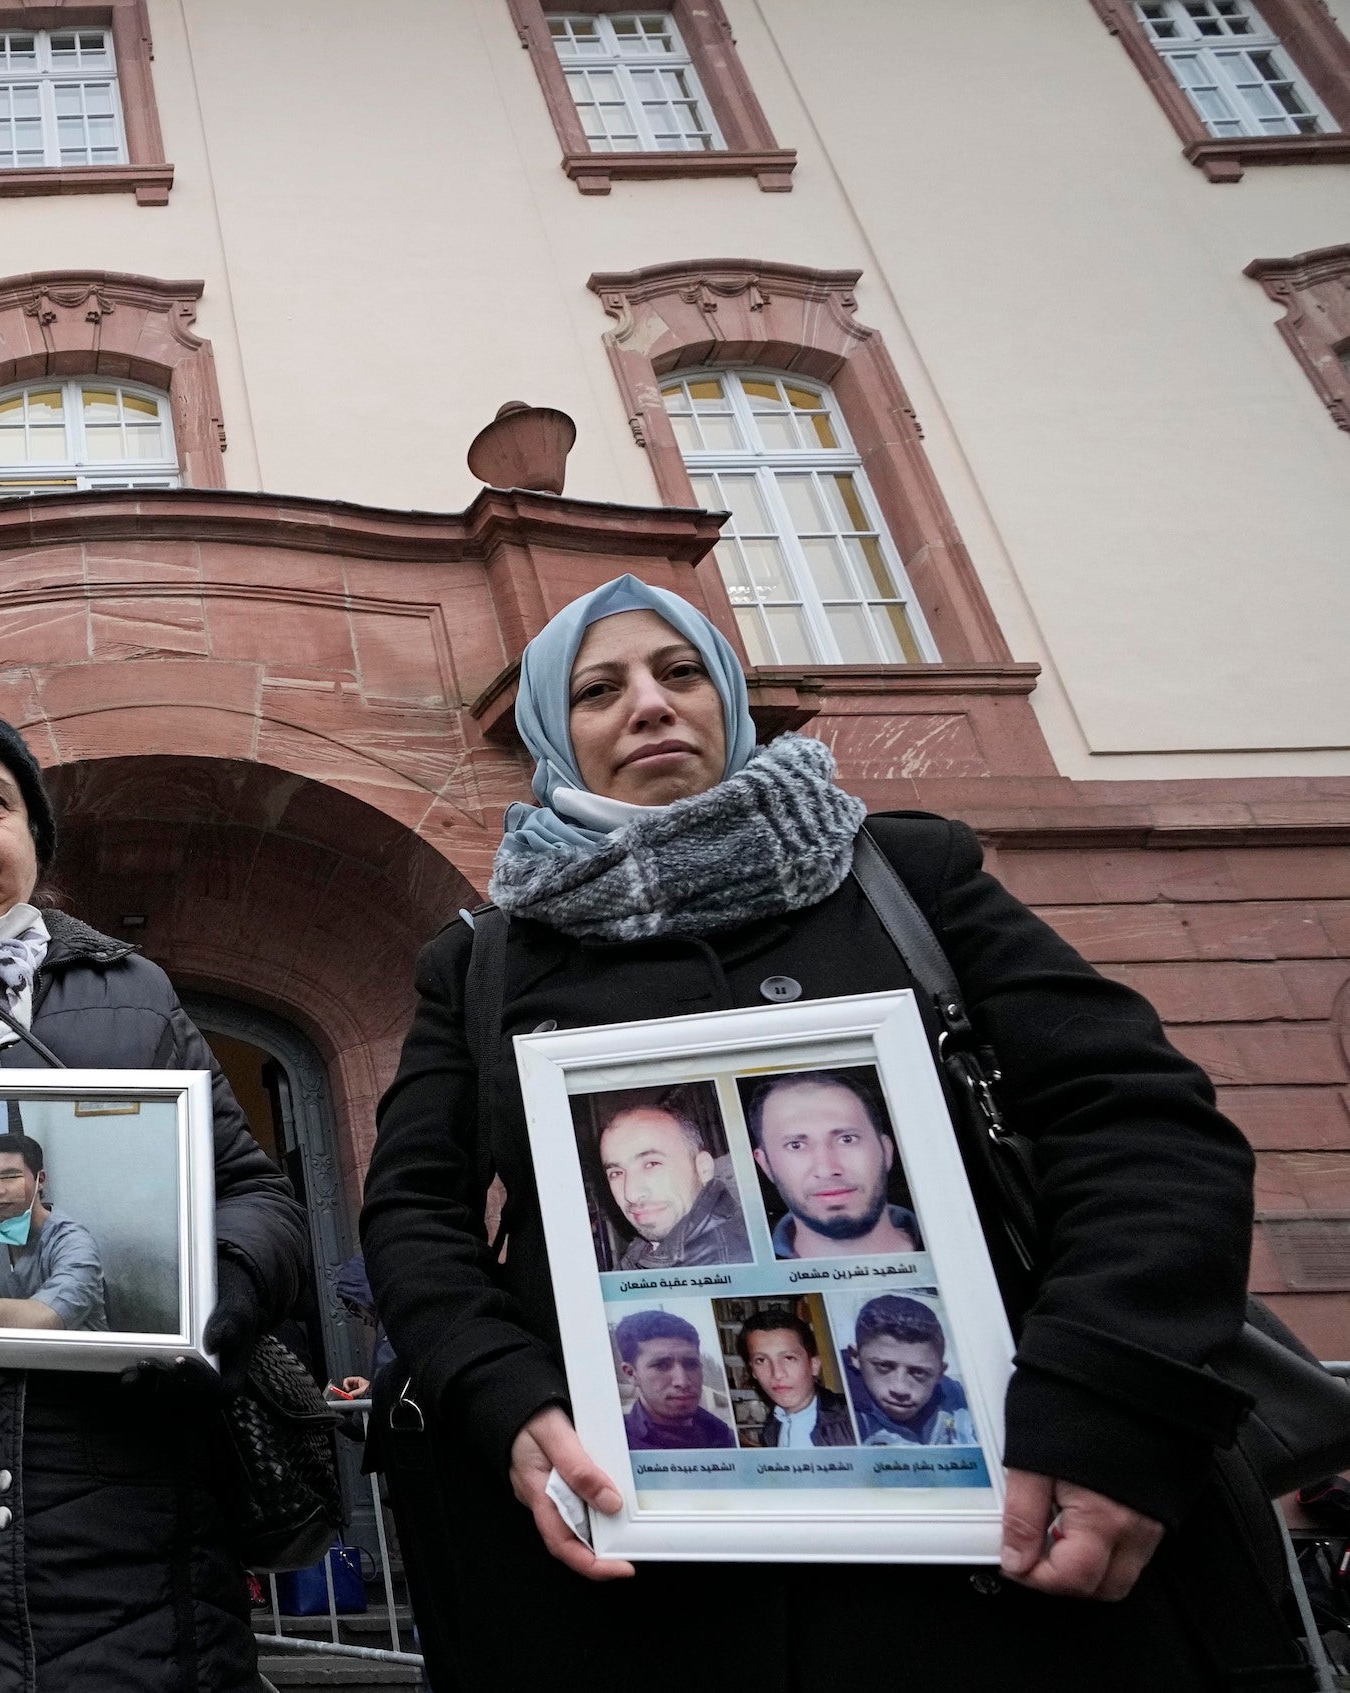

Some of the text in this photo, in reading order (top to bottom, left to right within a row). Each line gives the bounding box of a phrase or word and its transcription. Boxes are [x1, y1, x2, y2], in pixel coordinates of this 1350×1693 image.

[789, 1263, 918, 1282] الشهيد تشرين مشعان
[620, 1274, 732, 1292] الشهيد عقبة مشعان
[637, 1462, 736, 1475] الشهيد عبيدة مشعان
[757, 1462, 790, 1475] مشعان
[815, 1461, 854, 1474] الشهيد
[873, 1460, 910, 1473] مشعان
[937, 1460, 978, 1472] الشهيد
